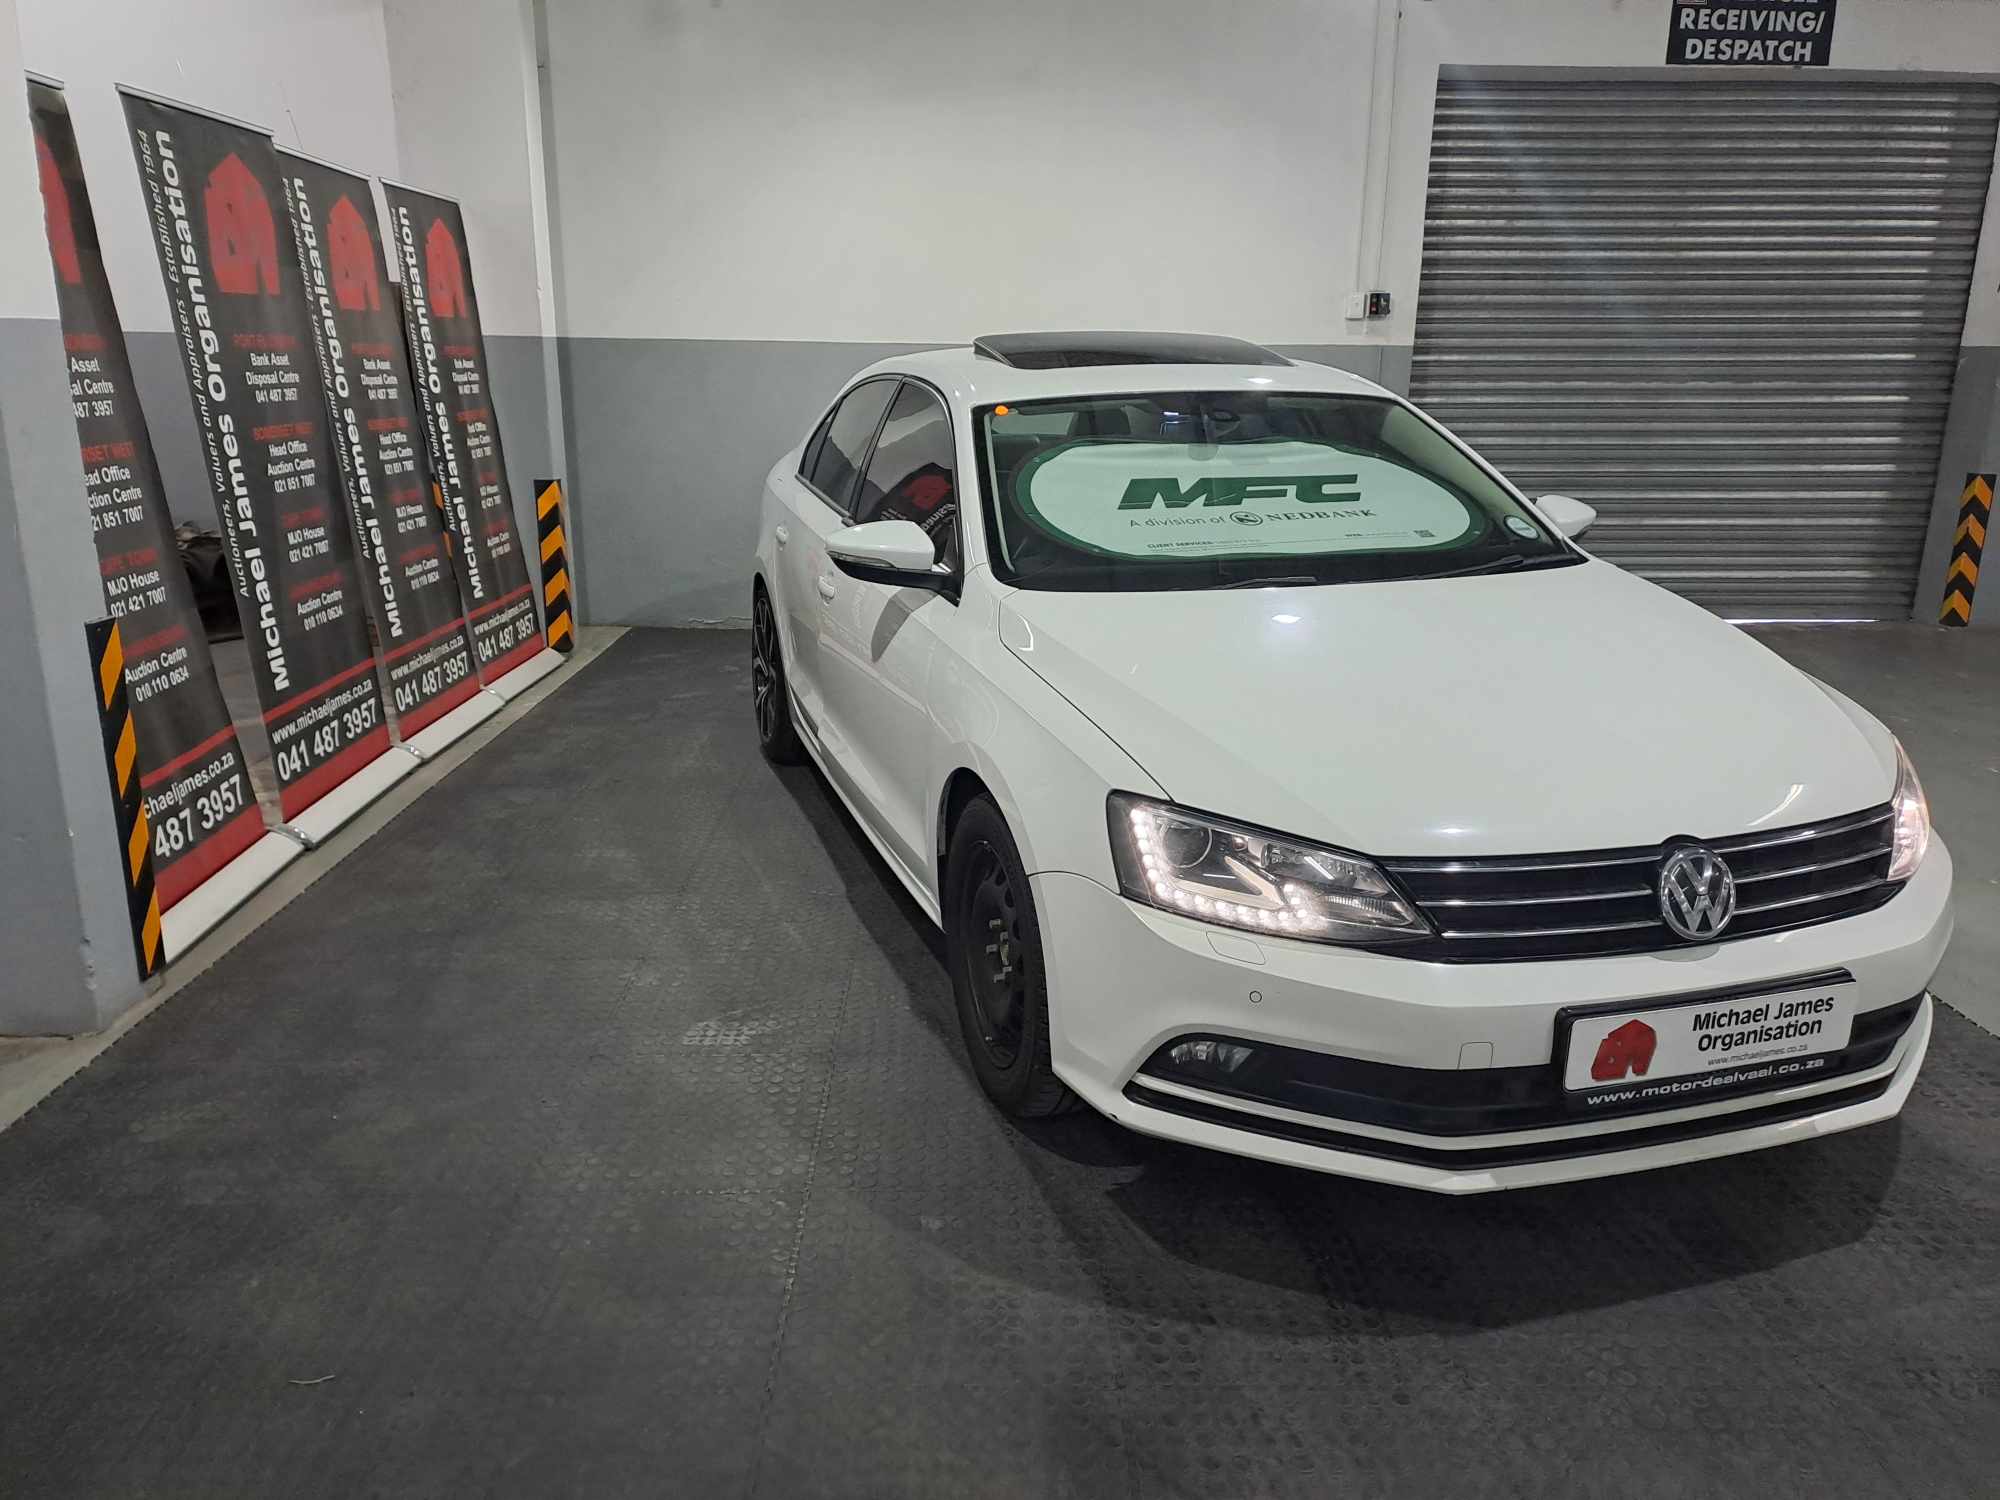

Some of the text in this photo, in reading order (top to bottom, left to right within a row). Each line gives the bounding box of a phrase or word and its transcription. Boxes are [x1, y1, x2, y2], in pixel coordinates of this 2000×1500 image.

[1680, 8, 1826, 33] RECEIVING/
[1684, 38, 1813, 62] DESPATCH
[137, 128, 156, 175] 1964
[147, 178, 180, 284] Established
[293, 178, 349, 398] Organisation
[399, 206, 441, 395] Organisation
[71, 357, 101, 372] Asset
[177, 299, 205, 391] Appraisers
[83, 378, 114, 395] Centre
[91, 400, 114, 417] 3957
[196, 393, 212, 427] and
[155, 130, 290, 691] Michael James Organisation
[206, 432, 227, 493] Valuers
[344, 407, 375, 509] James
[435, 402, 461, 489] James
[101, 465, 131, 483] Office
[112, 486, 143, 503] Centre
[1118, 474, 1361, 510] MFC
[91, 505, 144, 531] 21 851 7007
[1130, 508, 1378, 528] A division of NEDBANK
[222, 499, 250, 597] Auctioneers,
[453, 496, 484, 599] Michael
[107, 570, 161, 597] MJO House
[365, 518, 403, 637] Michael
[110, 601, 128, 618] 021
[128, 594, 146, 612] 421
[478, 612, 534, 662] 041 487 3957
[124, 646, 188, 685] Auction Centre
[395, 651, 469, 712] 041 487 3957
[271, 679, 374, 744] www.michaeljames.co.za
[277, 697, 377, 780] 041 487 3957
[143, 752, 235, 819] chaeljames.co.za
[155, 773, 243, 858] 487 3957
[1692, 996, 1835, 1031] Michael James
[1697, 1019, 1823, 1051] Organisation
[1587, 1058, 1824, 1105] www.motordealvaal.co.za
